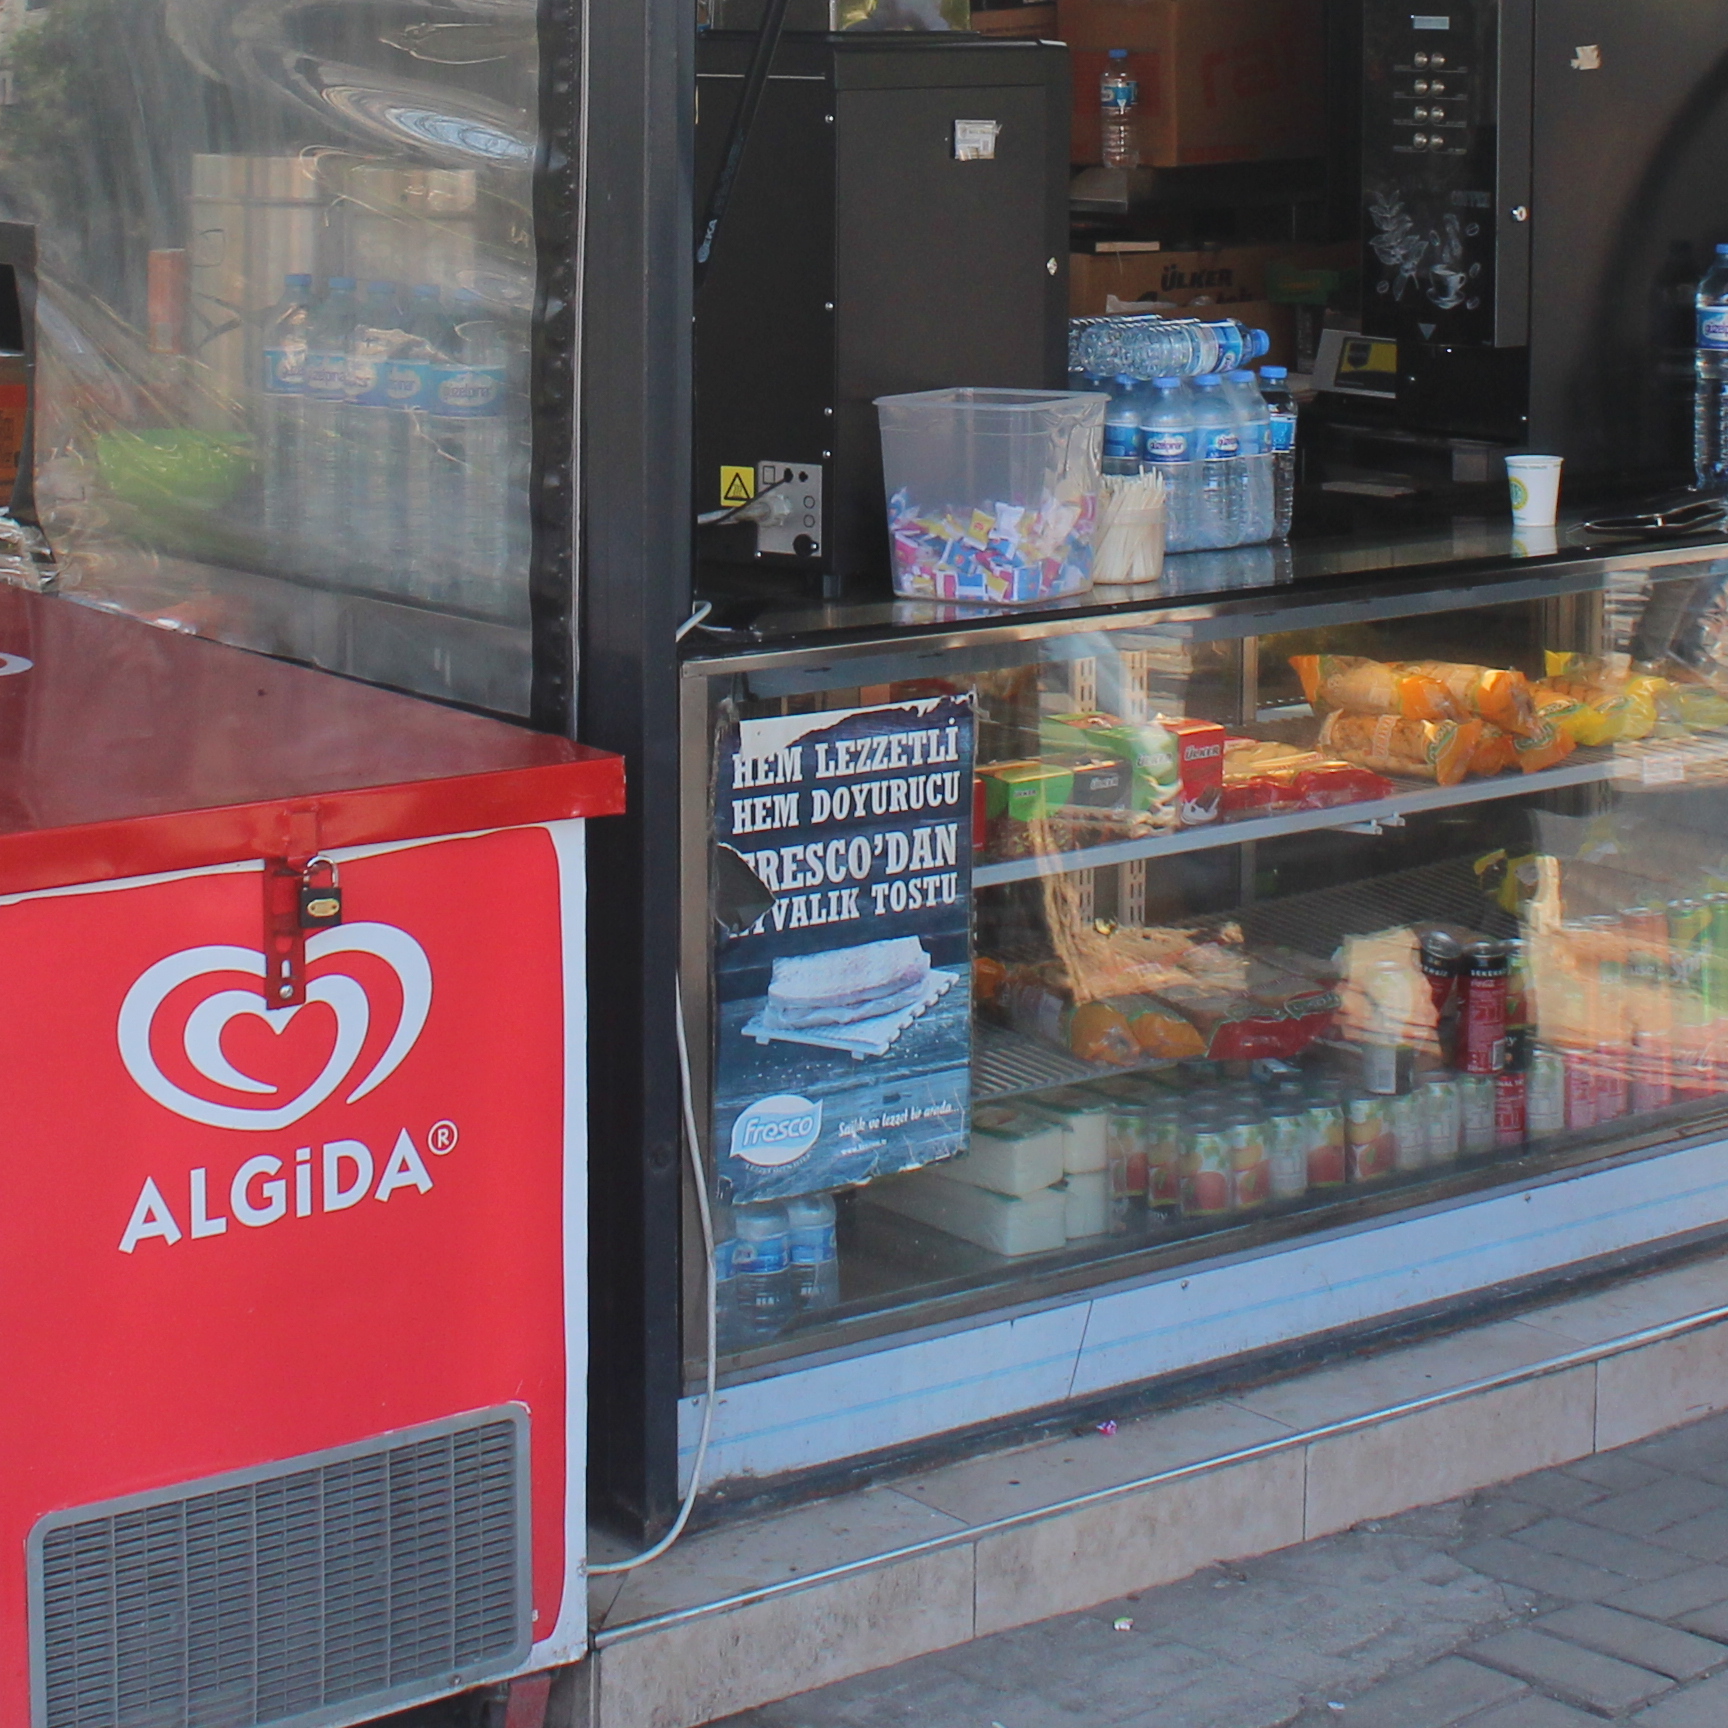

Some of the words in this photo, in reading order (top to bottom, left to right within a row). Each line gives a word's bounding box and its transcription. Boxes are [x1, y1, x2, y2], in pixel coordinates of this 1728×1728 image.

[1161, 263, 1233, 292] ÜLKER
[732, 746, 803, 790] HEM
[815, 717, 959, 779] LEZZETLİ
[732, 792, 800, 835] HEM
[812, 770, 960, 824] DOYURUCU
[729, 887, 860, 939] VALIK
[871, 872, 958, 916] TOSTU
